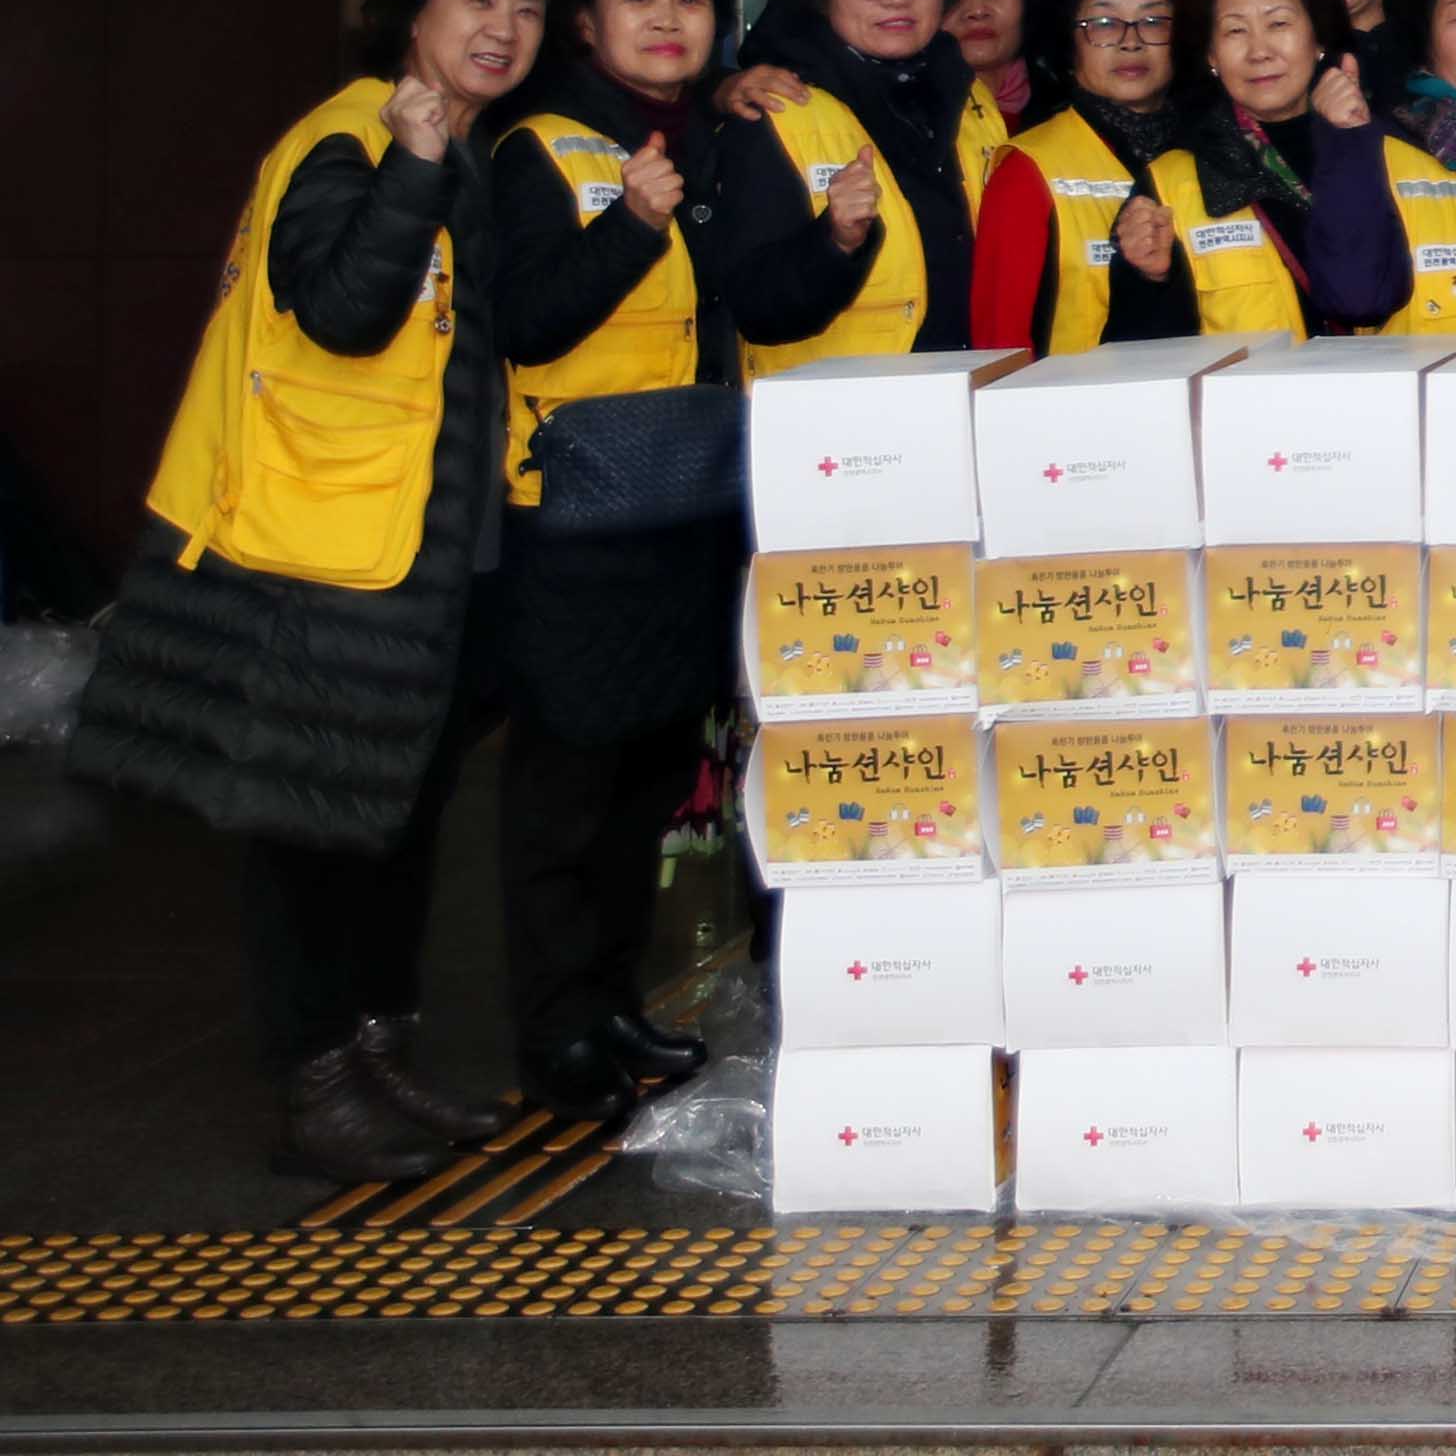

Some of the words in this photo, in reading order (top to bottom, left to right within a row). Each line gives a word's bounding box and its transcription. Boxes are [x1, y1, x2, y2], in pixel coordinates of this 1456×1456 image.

[777, 574, 940, 617] 나눔션샤인
[996, 581, 1157, 625] 나눔션샤인
[1226, 573, 1388, 611] 나눔션샤인
[783, 745, 945, 784] 나눔션샤인
[1017, 747, 1180, 790] 나눔션샤인
[1247, 739, 1409, 776] 나눔션샤인
